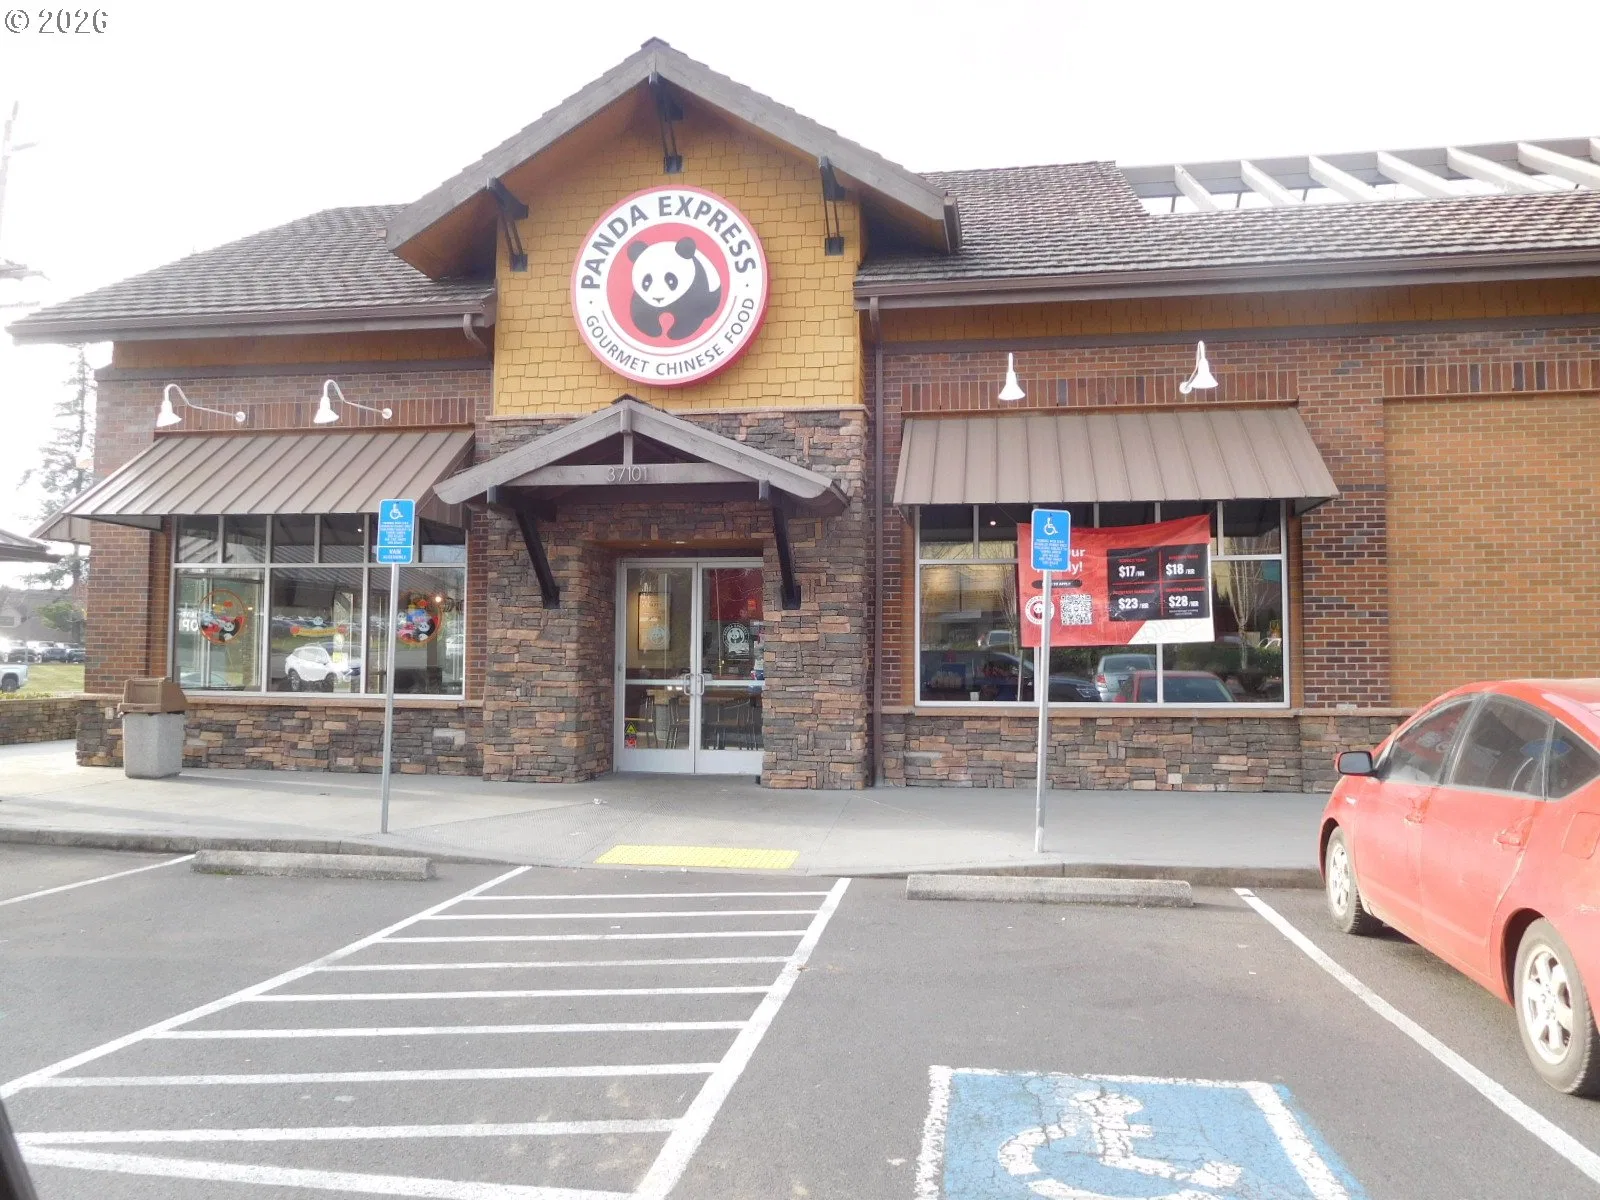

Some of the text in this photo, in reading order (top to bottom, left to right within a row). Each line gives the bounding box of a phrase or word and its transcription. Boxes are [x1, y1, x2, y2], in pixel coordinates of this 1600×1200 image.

[580, 195, 757, 290] PANDA EXPRESS
[586, 298, 755, 376] GOURMET CHINESE FOOD
[608, 466, 648, 482] 37101
[1118, 565, 1136, 578] $17
[1165, 563, 1184, 576] $18
[1118, 597, 1139, 611] $23
[1168, 595, 1189, 608] $28
